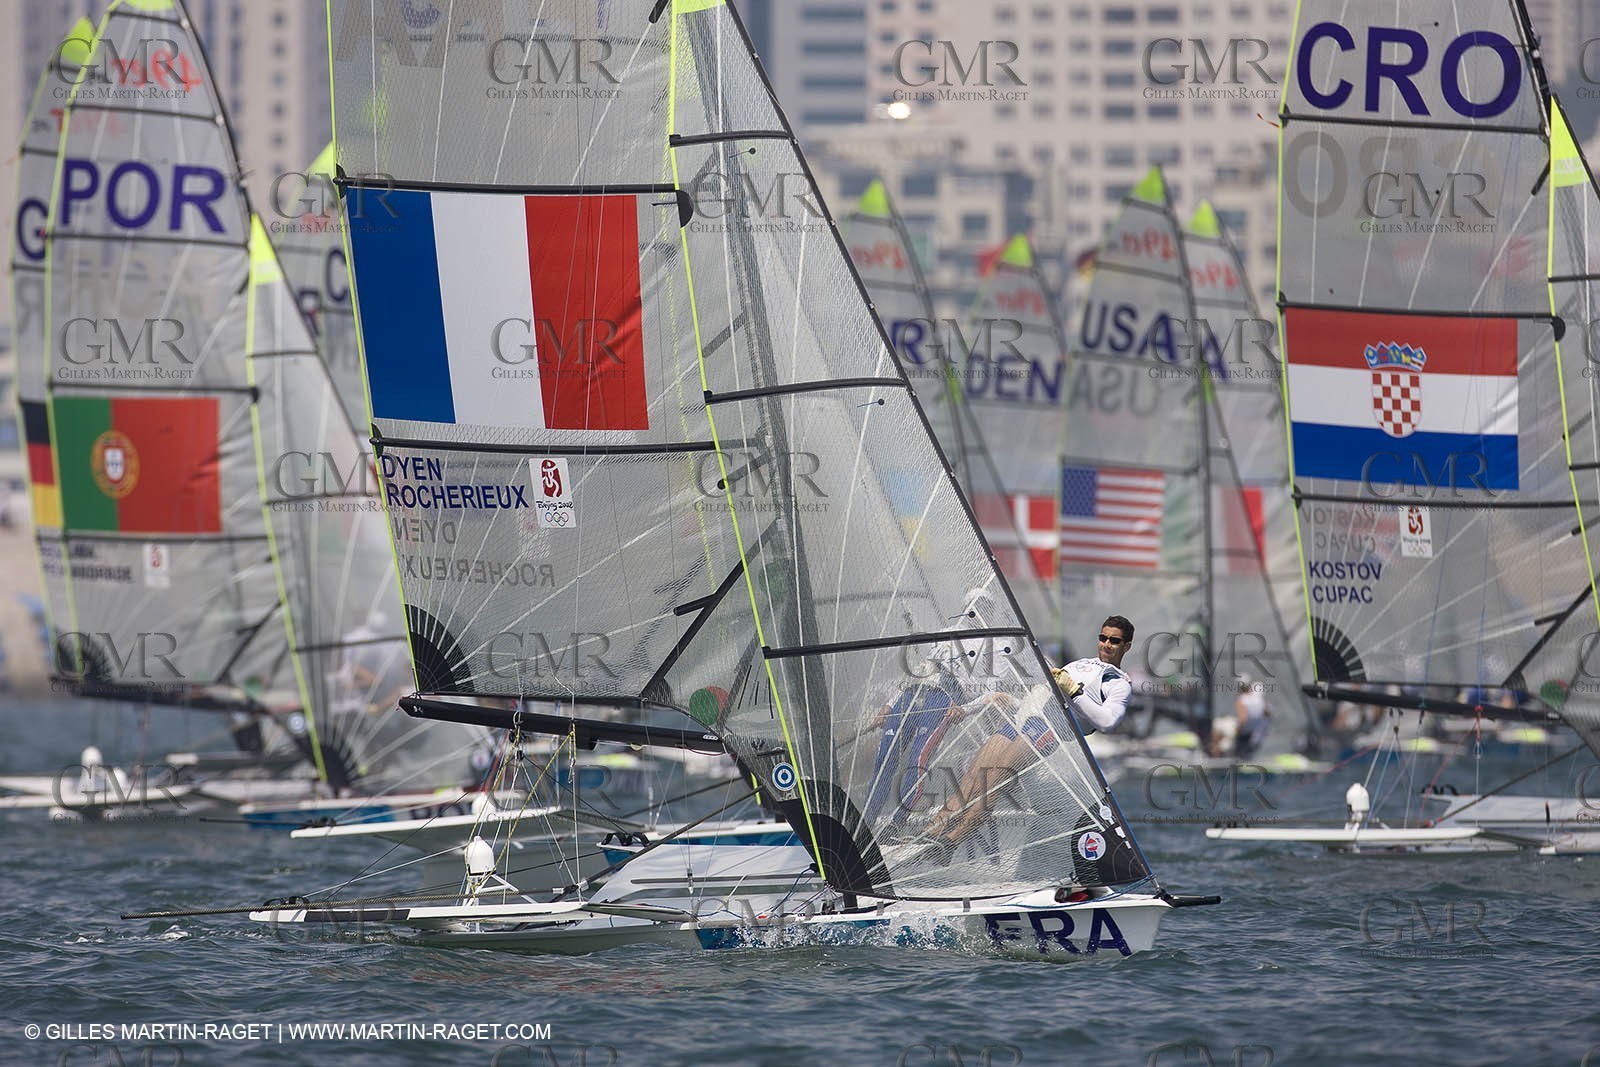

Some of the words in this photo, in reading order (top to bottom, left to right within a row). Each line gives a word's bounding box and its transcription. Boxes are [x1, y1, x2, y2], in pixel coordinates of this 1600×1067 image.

[1297, 22, 1522, 118] CRO
[59, 159, 226, 233] POR
[1081, 302, 1177, 362] USA
[966, 354, 1065, 401] DEN
[382, 455, 443, 481] DYEN
[386, 482, 529, 509] ROCHERIEUX
[1309, 560, 1382, 581] KOSTOV
[1313, 585, 1373, 604] CUPAC
[984, 907, 1132, 957] FRA
